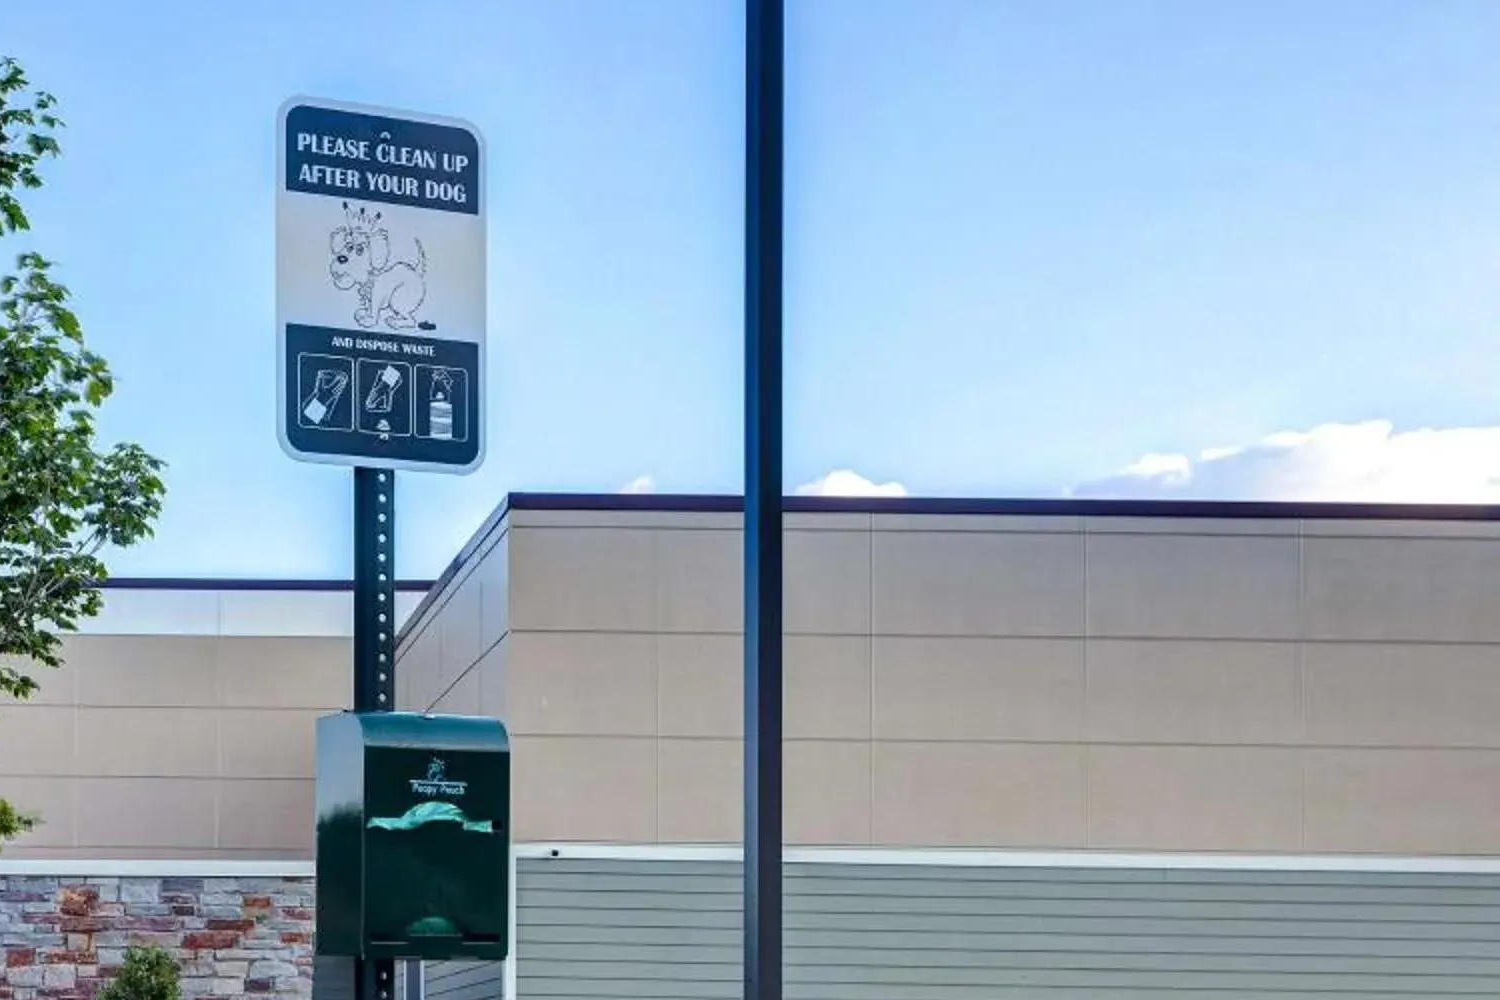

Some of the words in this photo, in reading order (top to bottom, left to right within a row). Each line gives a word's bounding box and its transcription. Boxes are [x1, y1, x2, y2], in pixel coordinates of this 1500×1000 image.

[297, 133, 370, 161] PLEASE
[376, 143, 436, 170] CLEAN
[443, 153, 469, 173] UP
[299, 164, 361, 189] AFTER
[366, 171, 419, 197] YOUR
[425, 179, 467, 203] DOG
[331, 336, 353, 349] AND
[355, 338, 400, 353] DISPOSE
[402, 343, 437, 357] WASTE
